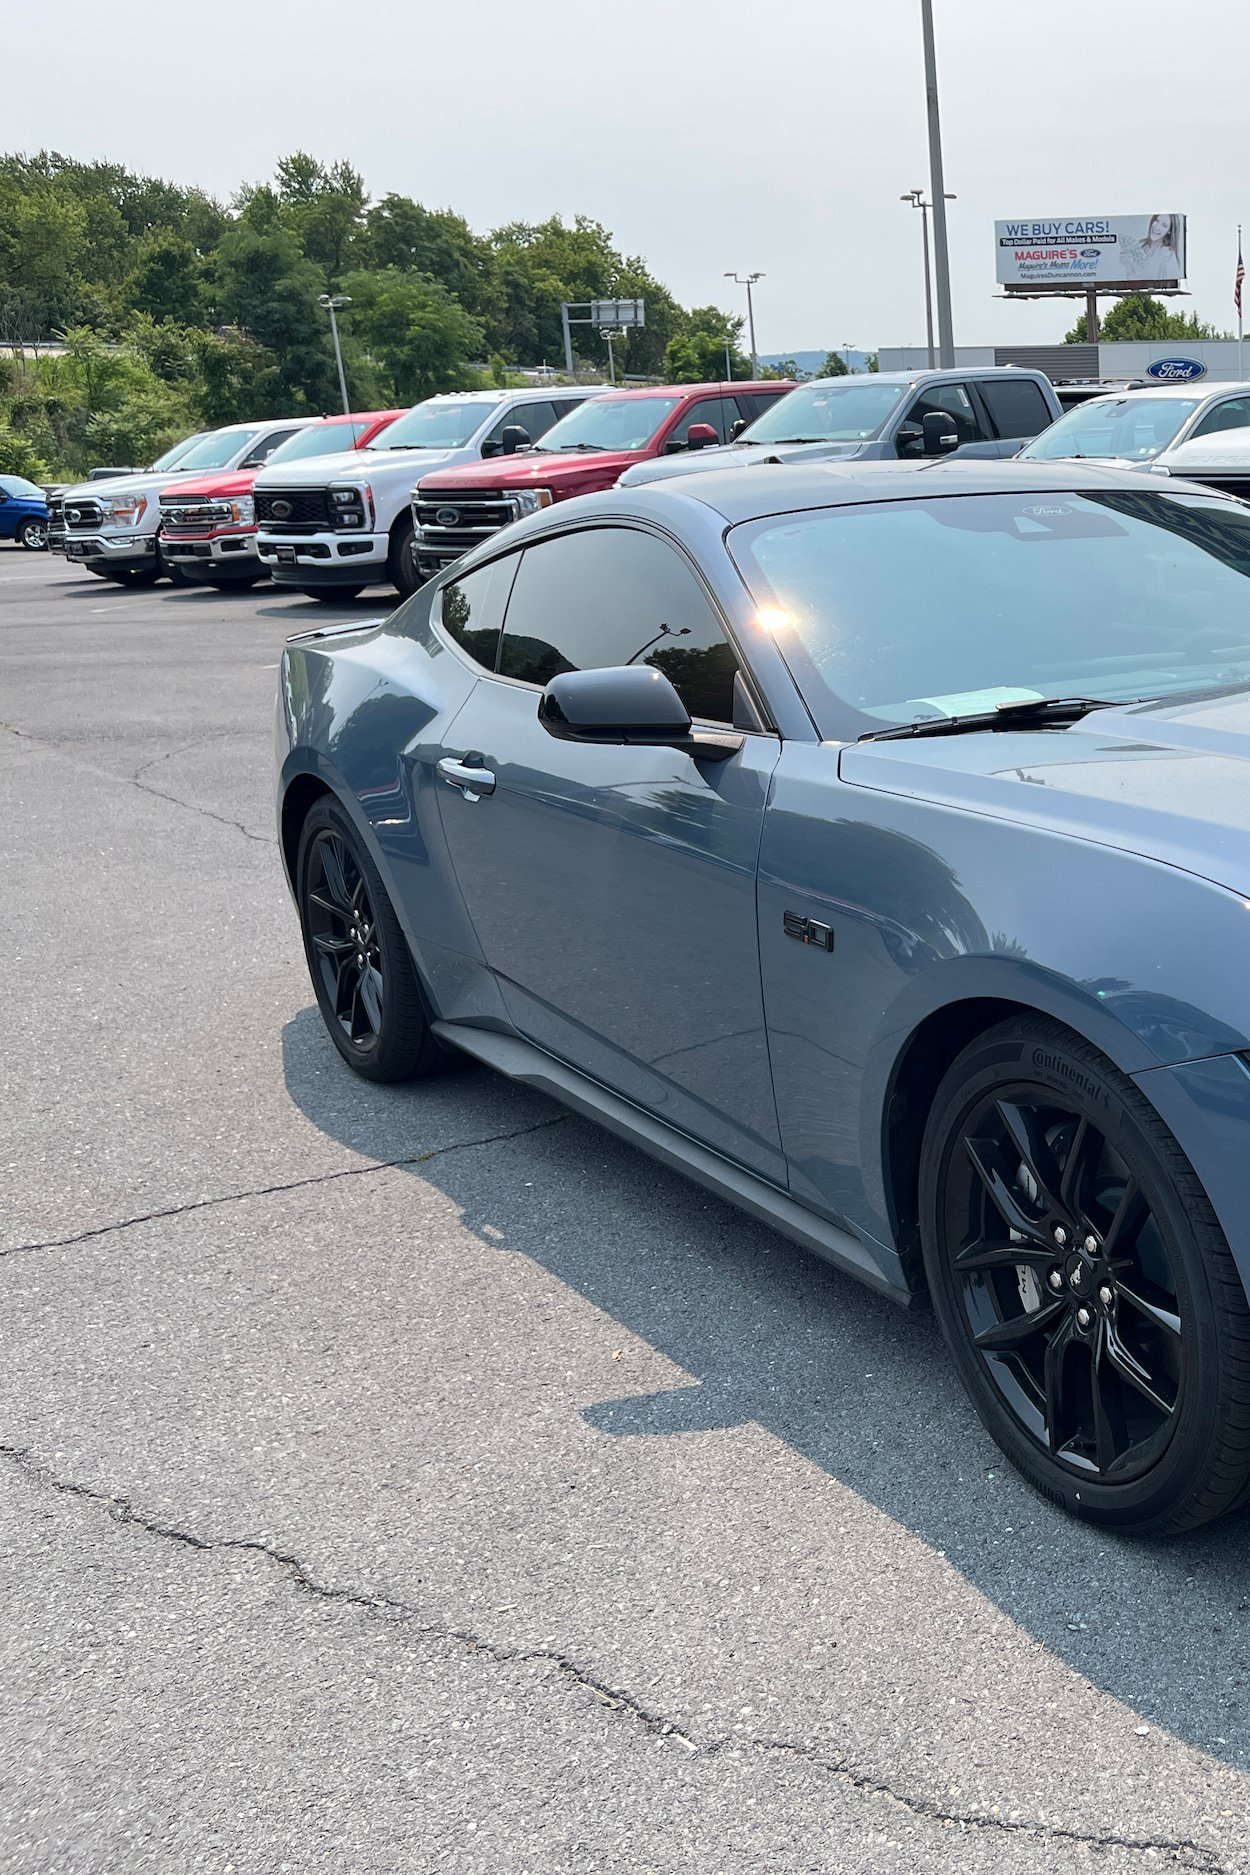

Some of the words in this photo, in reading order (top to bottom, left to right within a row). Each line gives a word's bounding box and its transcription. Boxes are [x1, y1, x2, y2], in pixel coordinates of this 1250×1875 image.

[1006, 224, 1029, 236] WE
[1032, 223, 1061, 236] BUY
[1065, 221, 1110, 234] CARS!
[1001, 238, 1014, 247] Top
[1033, 237, 1046, 245] Paid
[1056, 236, 1065, 244] All
[1066, 236, 1086, 244] Makes
[1092, 235, 1115, 243] Models
[1014, 248, 1078, 261] MAGUIRE'S
[1017, 262, 1048, 271] Maguire's
[1048, 261, 1070, 269] Means
[1070, 260, 1099, 270] More!
[1020, 271, 1097, 280] MaguiresDuncannon.com
[783, 909, 835, 953] 5.0
[1031, 1047, 1102, 1100] Continental
